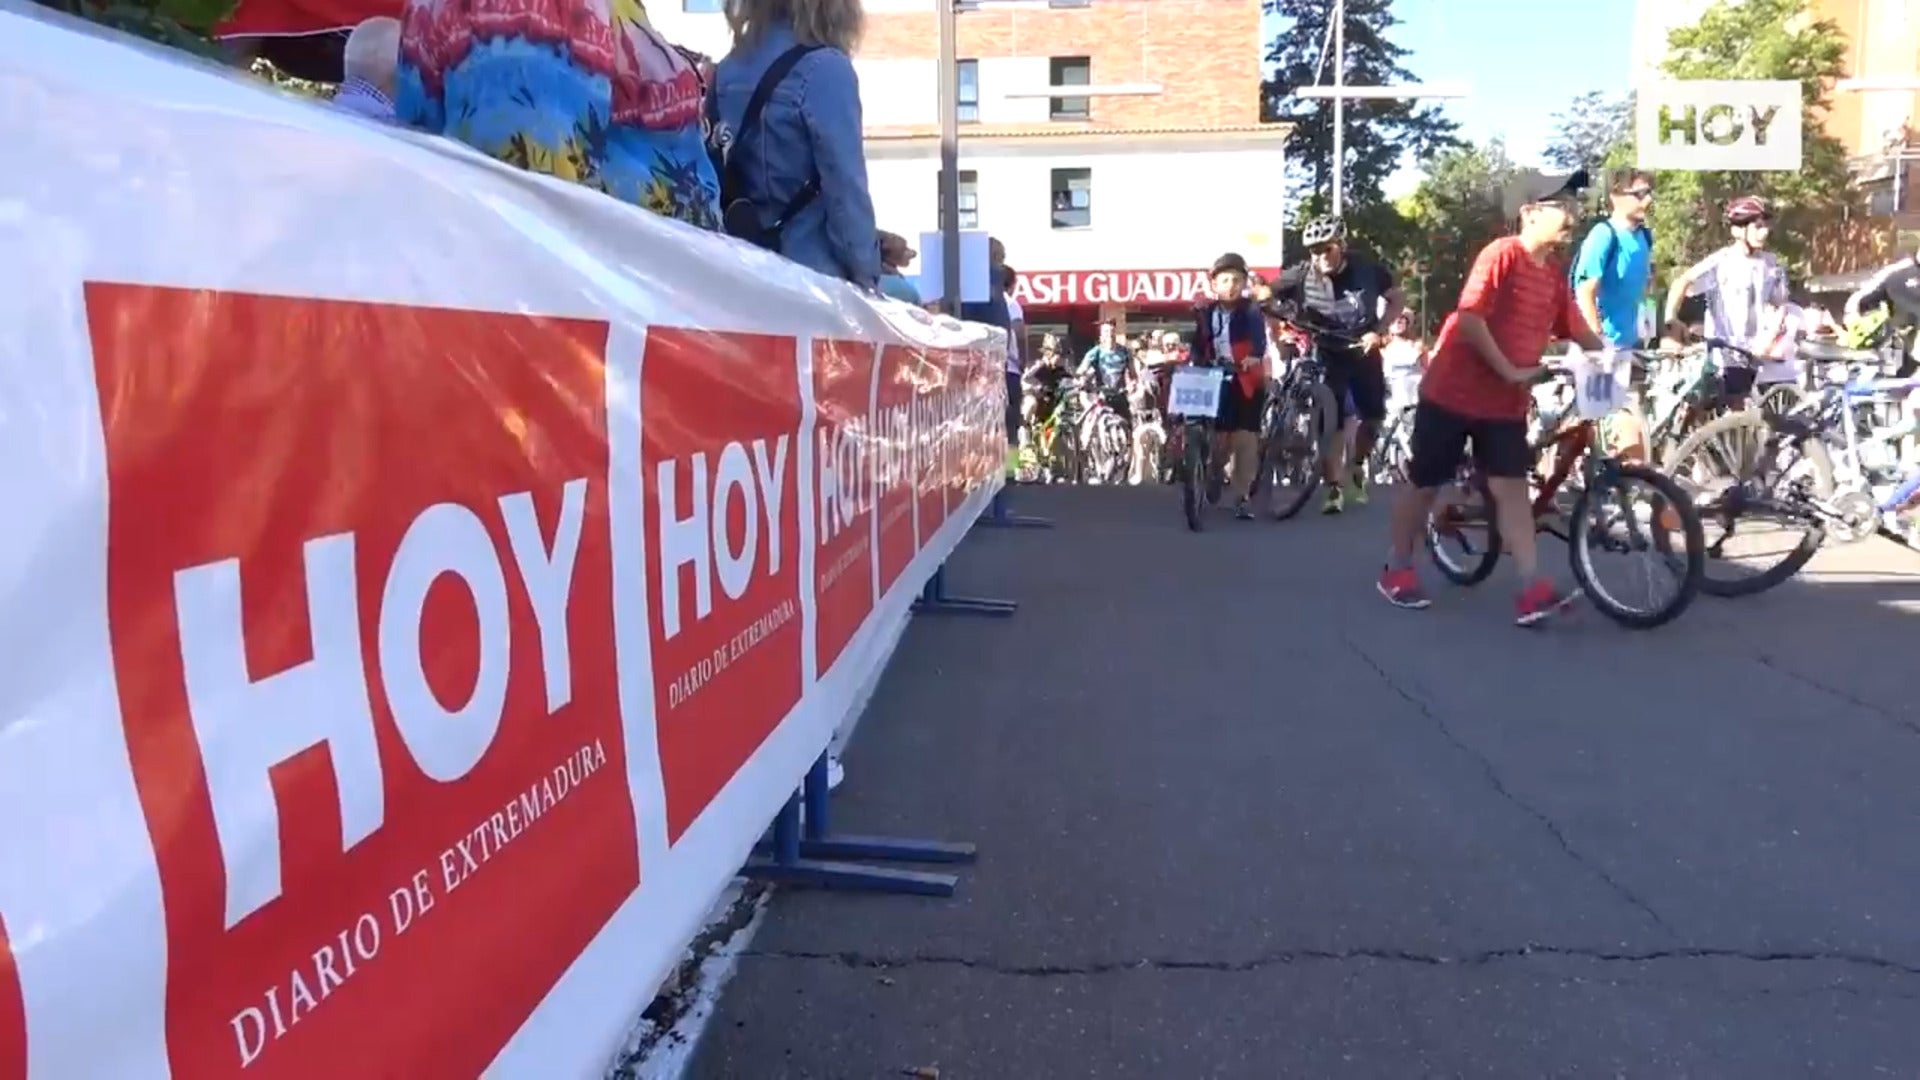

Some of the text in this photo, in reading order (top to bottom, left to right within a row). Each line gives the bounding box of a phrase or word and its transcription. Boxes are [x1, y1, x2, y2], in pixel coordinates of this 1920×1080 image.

[1012, 271, 1219, 304] ASH GUADIA
[657, 433, 789, 642] HOY
[173, 477, 589, 932] HOY
[669, 598, 796, 710] DIARIO DE EXTREMADURA
[230, 737, 607, 1068] DIARIO DE EXTREMADURA
